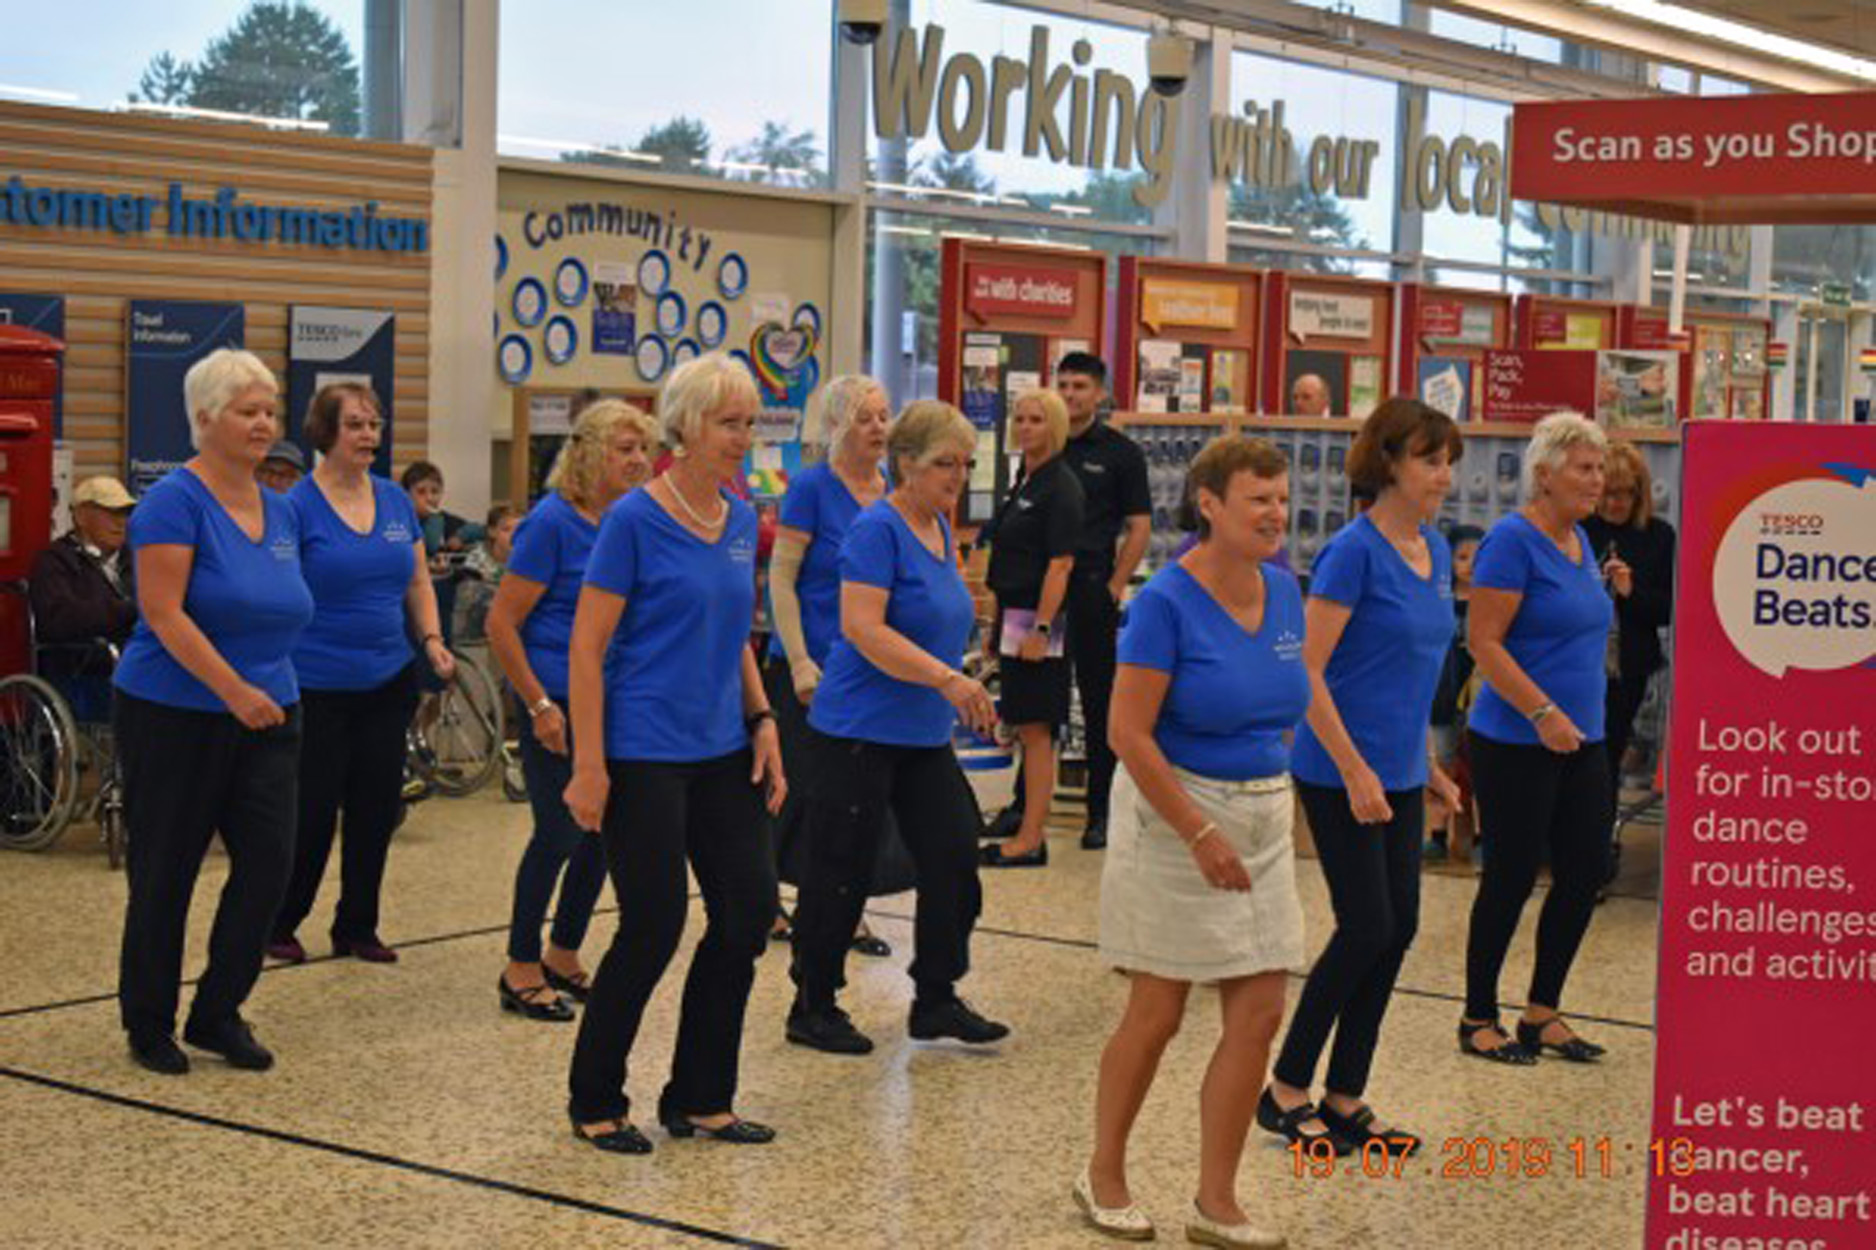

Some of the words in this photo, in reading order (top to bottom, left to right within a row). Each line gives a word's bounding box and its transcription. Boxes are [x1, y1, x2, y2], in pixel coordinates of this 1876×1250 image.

[872, 22, 1178, 208] Working
[1210, 100, 1293, 188] with
[1308, 133, 1380, 199] our
[1401, 98, 1512, 226] local
[1553, 127, 1643, 162] Scan
[1653, 134, 1694, 160] as
[1703, 133, 1775, 168] you
[1787, 121, 1876, 164] Shop
[168, 183, 428, 252] Information
[522, 202, 711, 271] Community
[1489, 352, 1525, 370] Scan,
[1489, 369, 1524, 386] Pack,
[1489, 386, 1512, 402] Pay
[1760, 514, 1823, 535] TESCO
[1756, 543, 1876, 583] Dance
[1698, 719, 1787, 752] Look
[1796, 724, 1862, 756] out
[1696, 764, 1750, 796] for
[1692, 809, 1808, 844] dance
[1691, 856, 1855, 893] routines,
[1687, 901, 1876, 944] challenges
[1687, 947, 1755, 977] and
[1673, 1096, 1765, 1128] Let's
[1776, 1099, 1864, 1131] beat
[1670, 1146, 1809, 1176] cancer,
[1668, 1183, 1755, 1217] beat
[1765, 1186, 1871, 1221] heart
